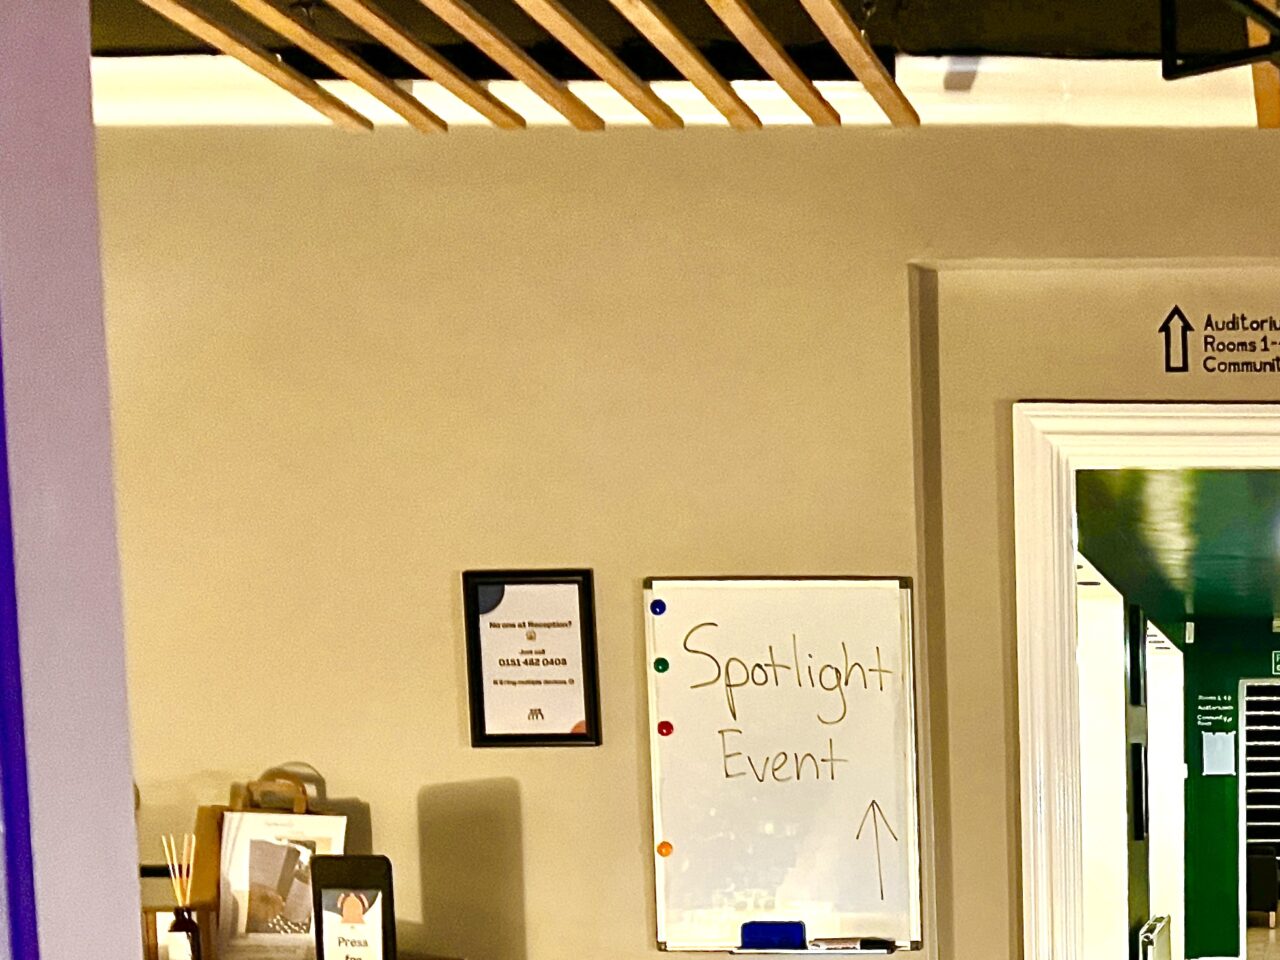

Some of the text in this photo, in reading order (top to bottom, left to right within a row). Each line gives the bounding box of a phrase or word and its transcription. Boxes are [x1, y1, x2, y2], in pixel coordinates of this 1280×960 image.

[1203, 335, 1257, 352] Rooms
[498, 658, 521, 667] 0151
[683, 621, 894, 725] Spotlight
[717, 728, 849, 783] Event
[337, 936, 369, 947] Press
